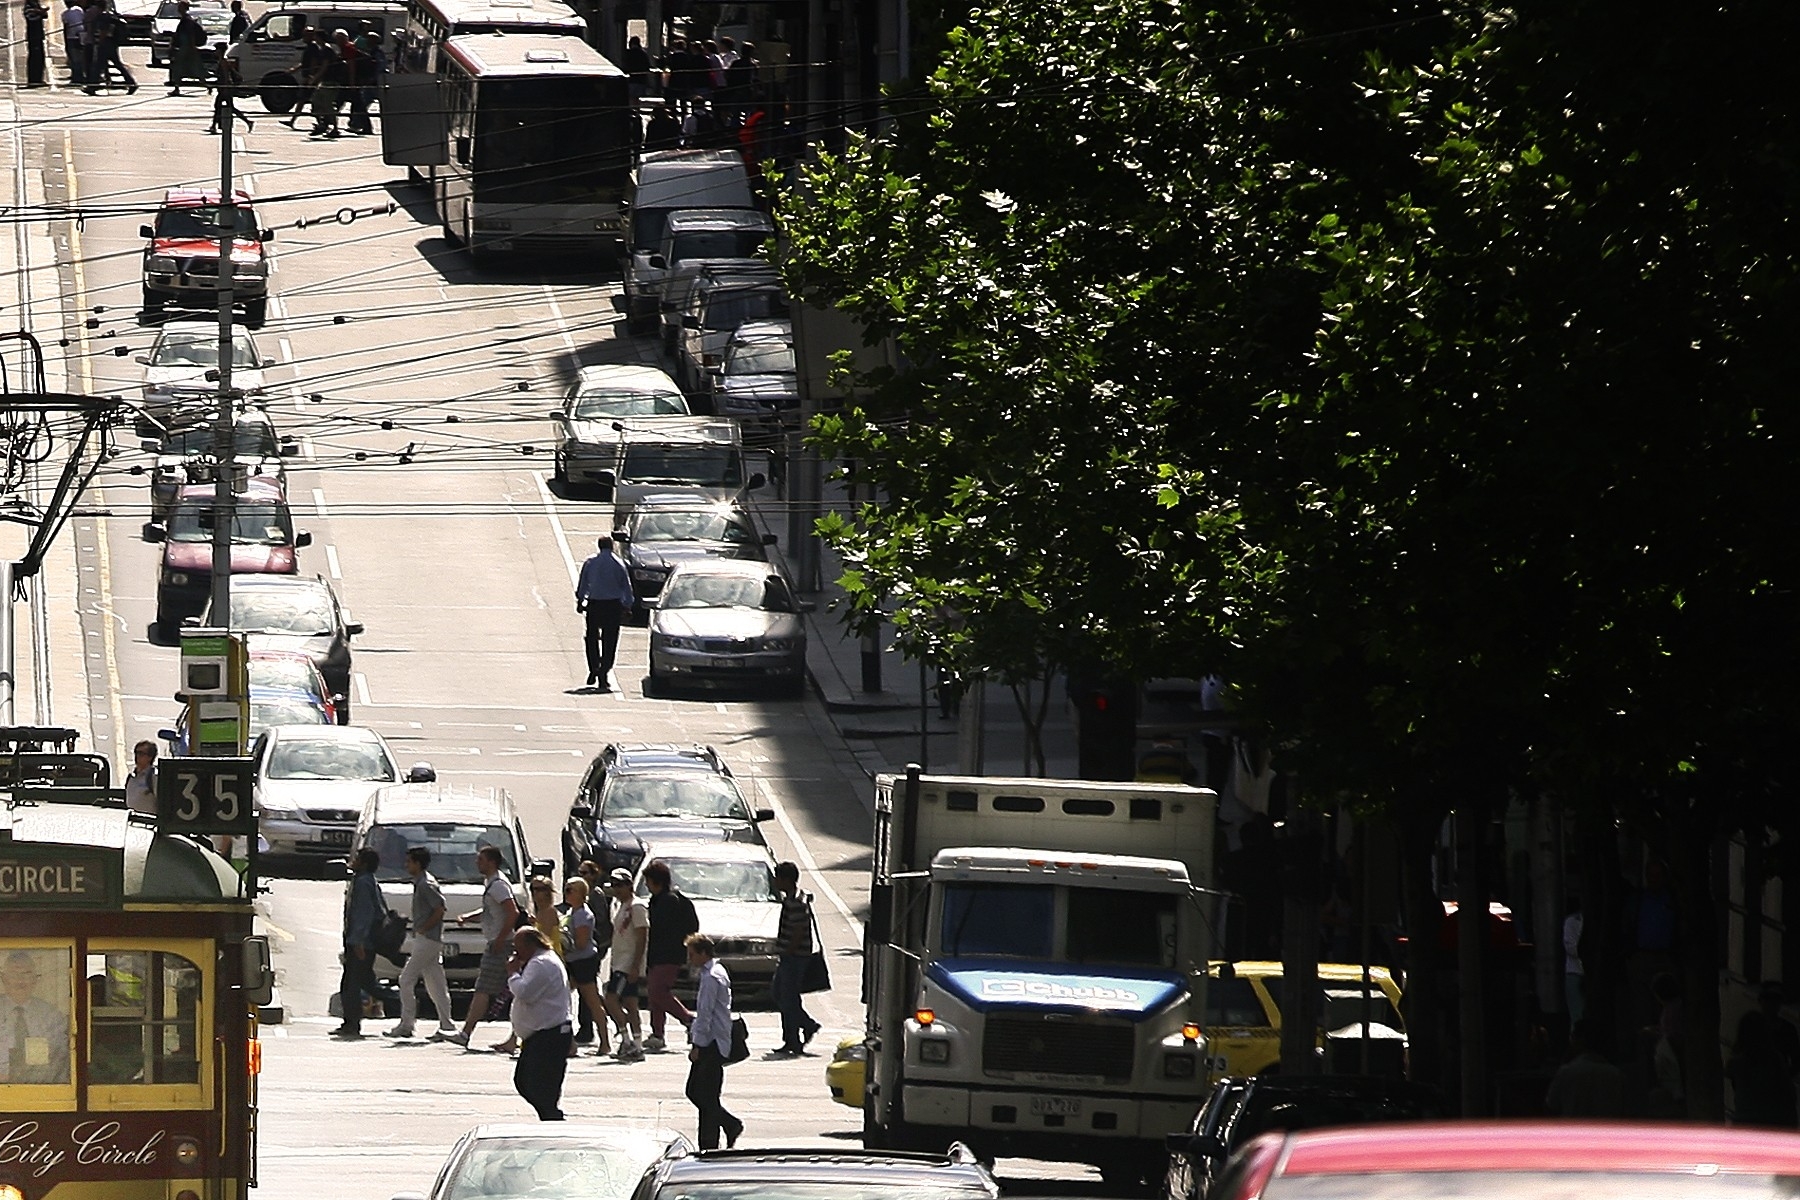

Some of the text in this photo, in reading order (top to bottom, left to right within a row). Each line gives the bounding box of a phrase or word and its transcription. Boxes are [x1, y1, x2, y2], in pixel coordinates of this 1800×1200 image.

[176, 773, 240, 821] 35
[1025, 981, 1139, 1001] Chubb
[71, 1120, 166, 1165] Circle
